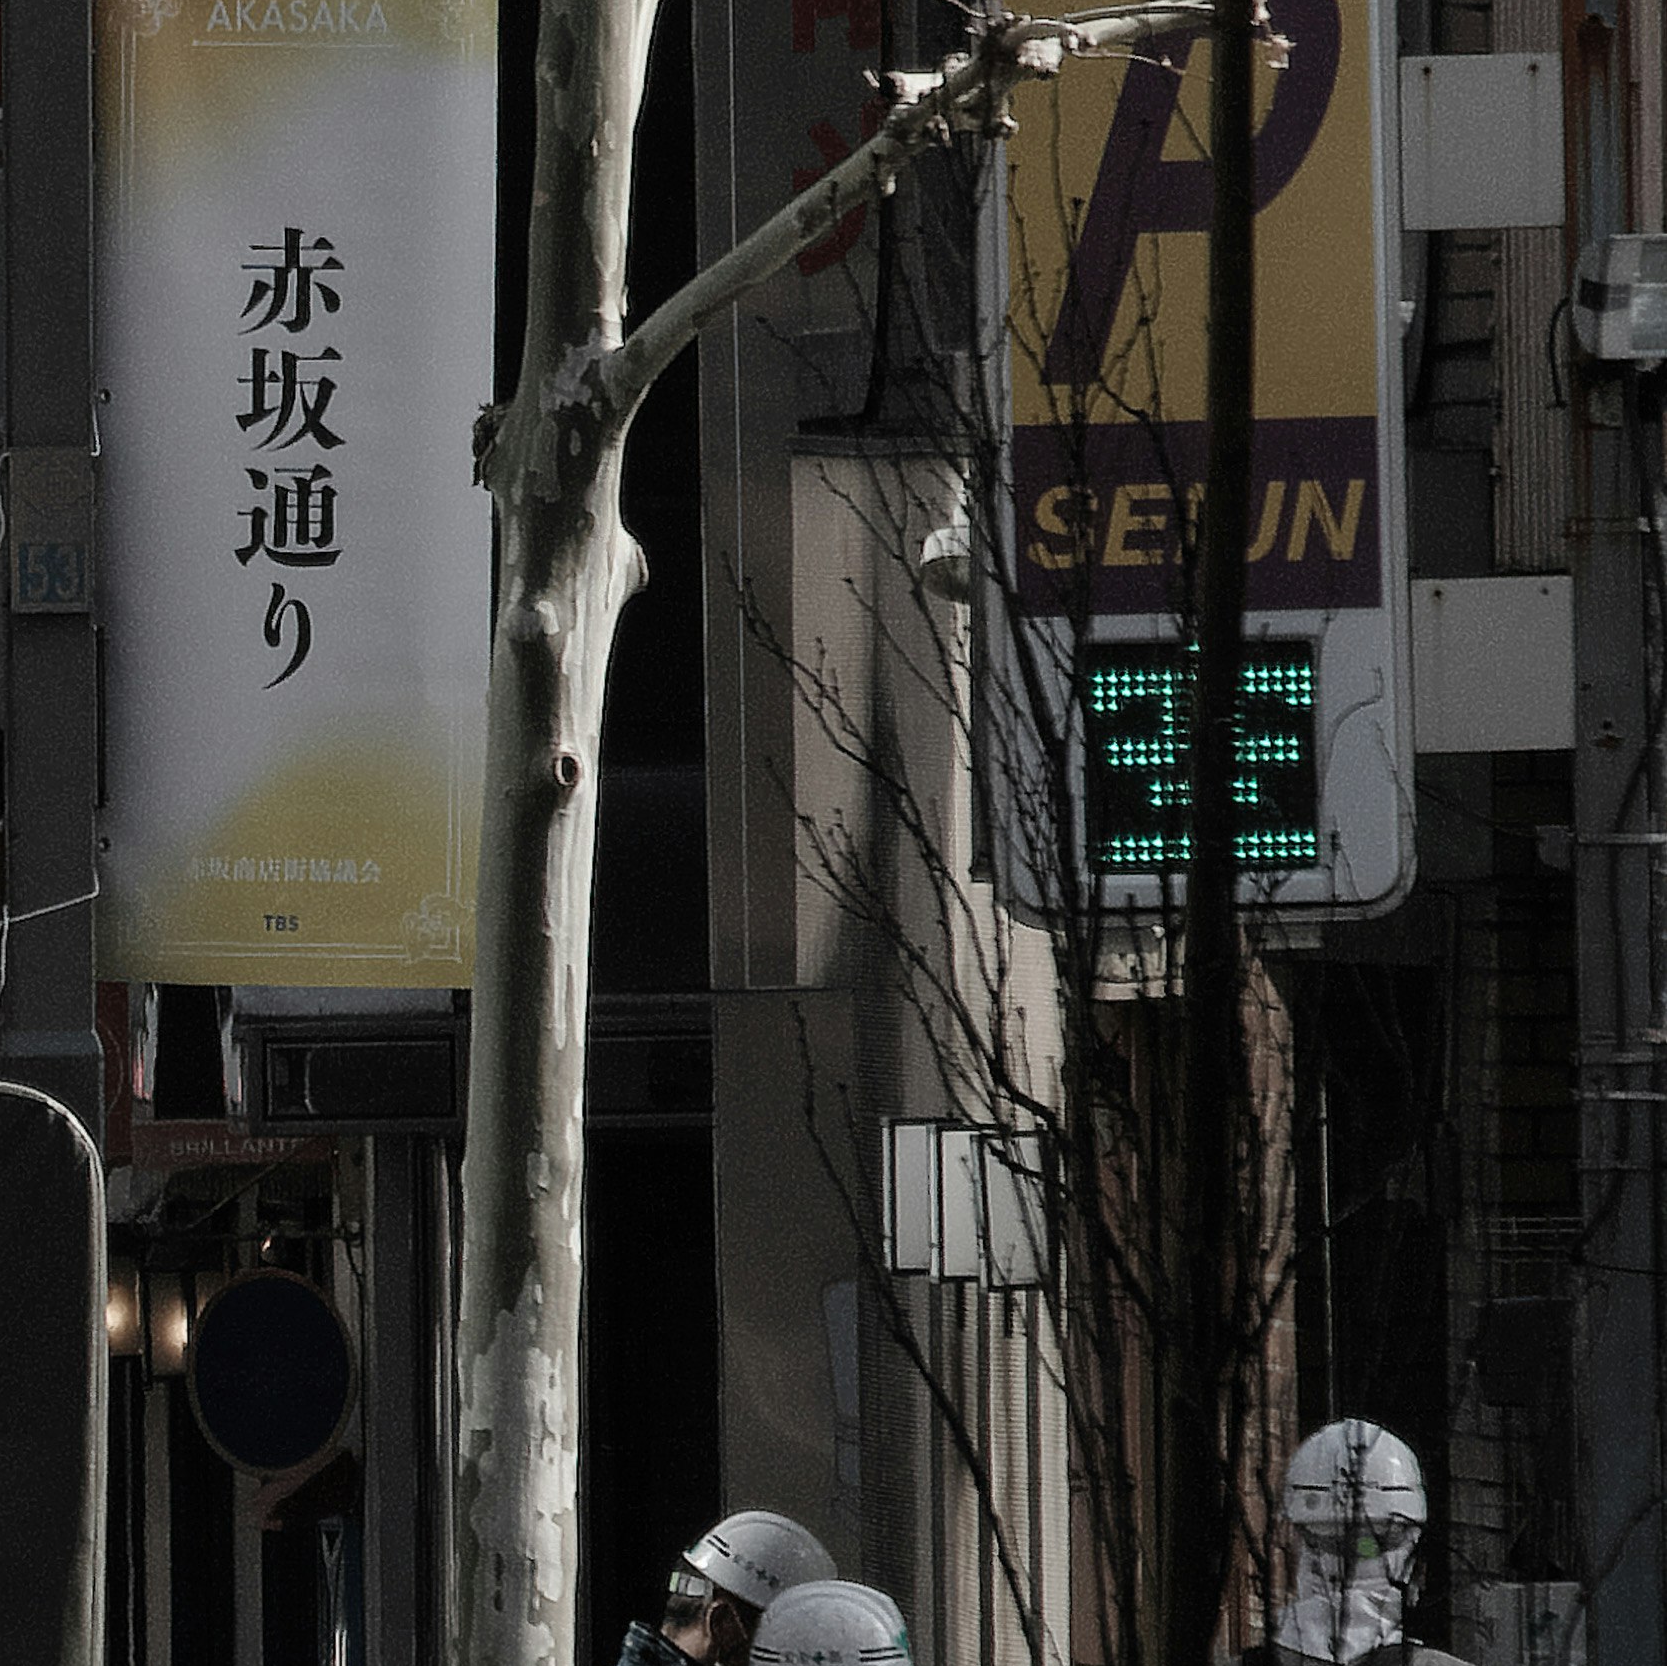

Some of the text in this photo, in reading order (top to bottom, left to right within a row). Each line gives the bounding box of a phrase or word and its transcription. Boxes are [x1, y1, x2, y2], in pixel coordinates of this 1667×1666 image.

[234, 226, 347, 691] 赤坂通り
[263, 915, 299, 932] TBS
